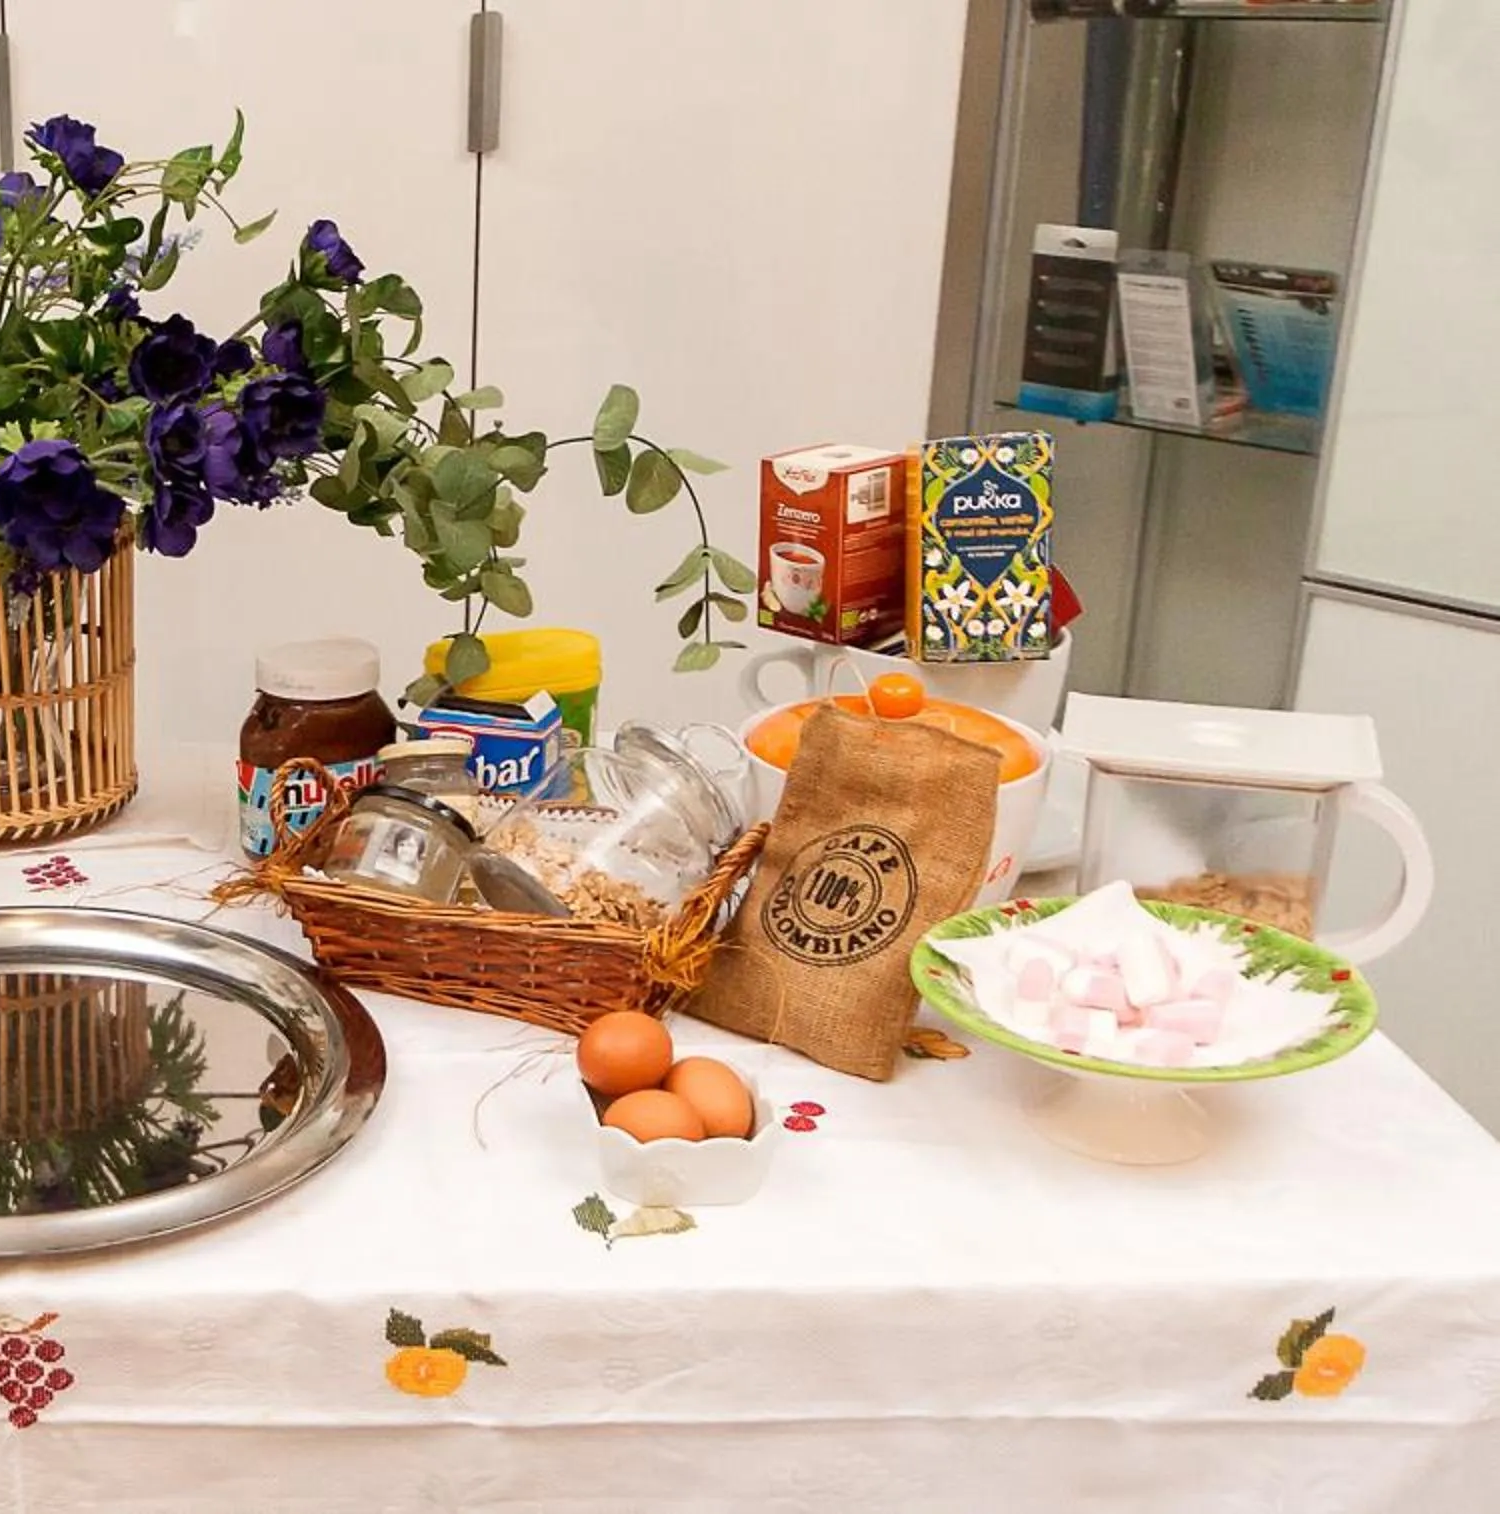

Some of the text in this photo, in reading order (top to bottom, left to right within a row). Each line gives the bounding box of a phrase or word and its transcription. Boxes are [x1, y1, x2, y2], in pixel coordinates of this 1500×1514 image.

[953, 487, 1022, 515] pukka
[467, 746, 541, 790] bar
[770, 875, 897, 955] COLOMBIANO
[804, 867, 868, 917] 100%
